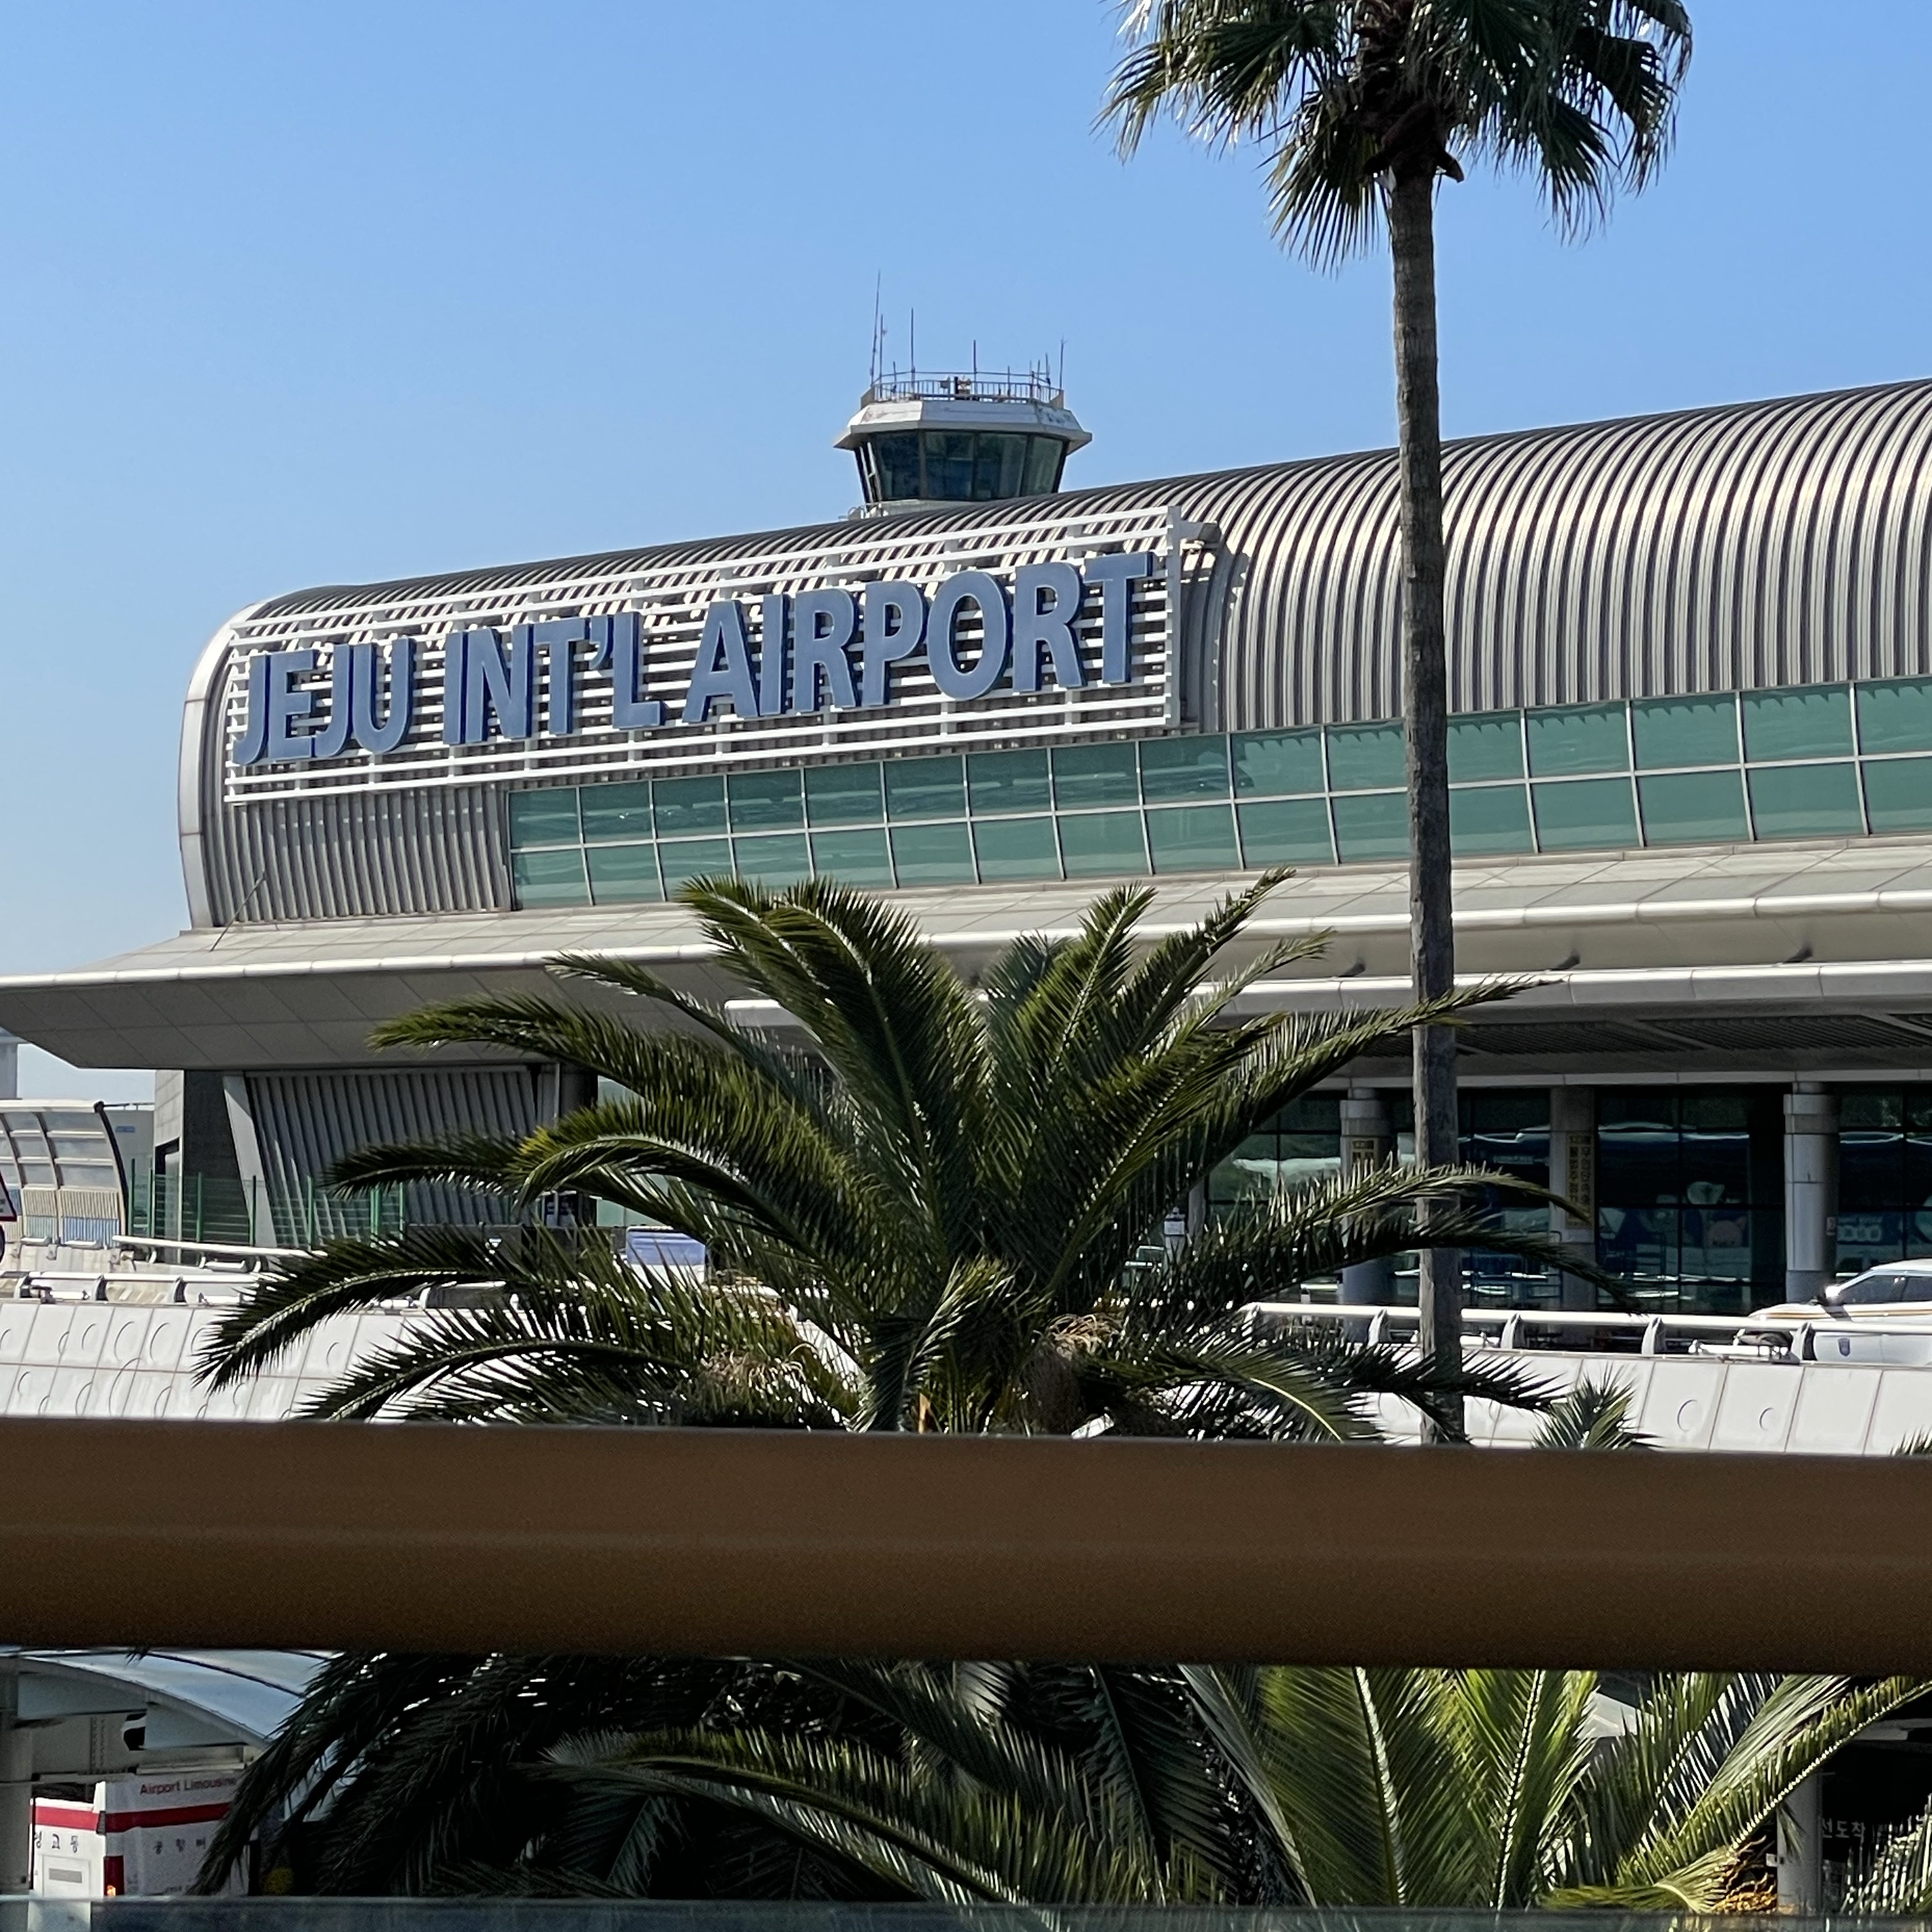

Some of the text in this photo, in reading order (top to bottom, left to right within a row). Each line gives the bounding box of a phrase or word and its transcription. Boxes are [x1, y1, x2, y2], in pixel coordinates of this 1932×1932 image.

[233, 551, 1154, 765] JEJU INT'L AIRPORT
[140, 1781, 180, 1795] Airport
